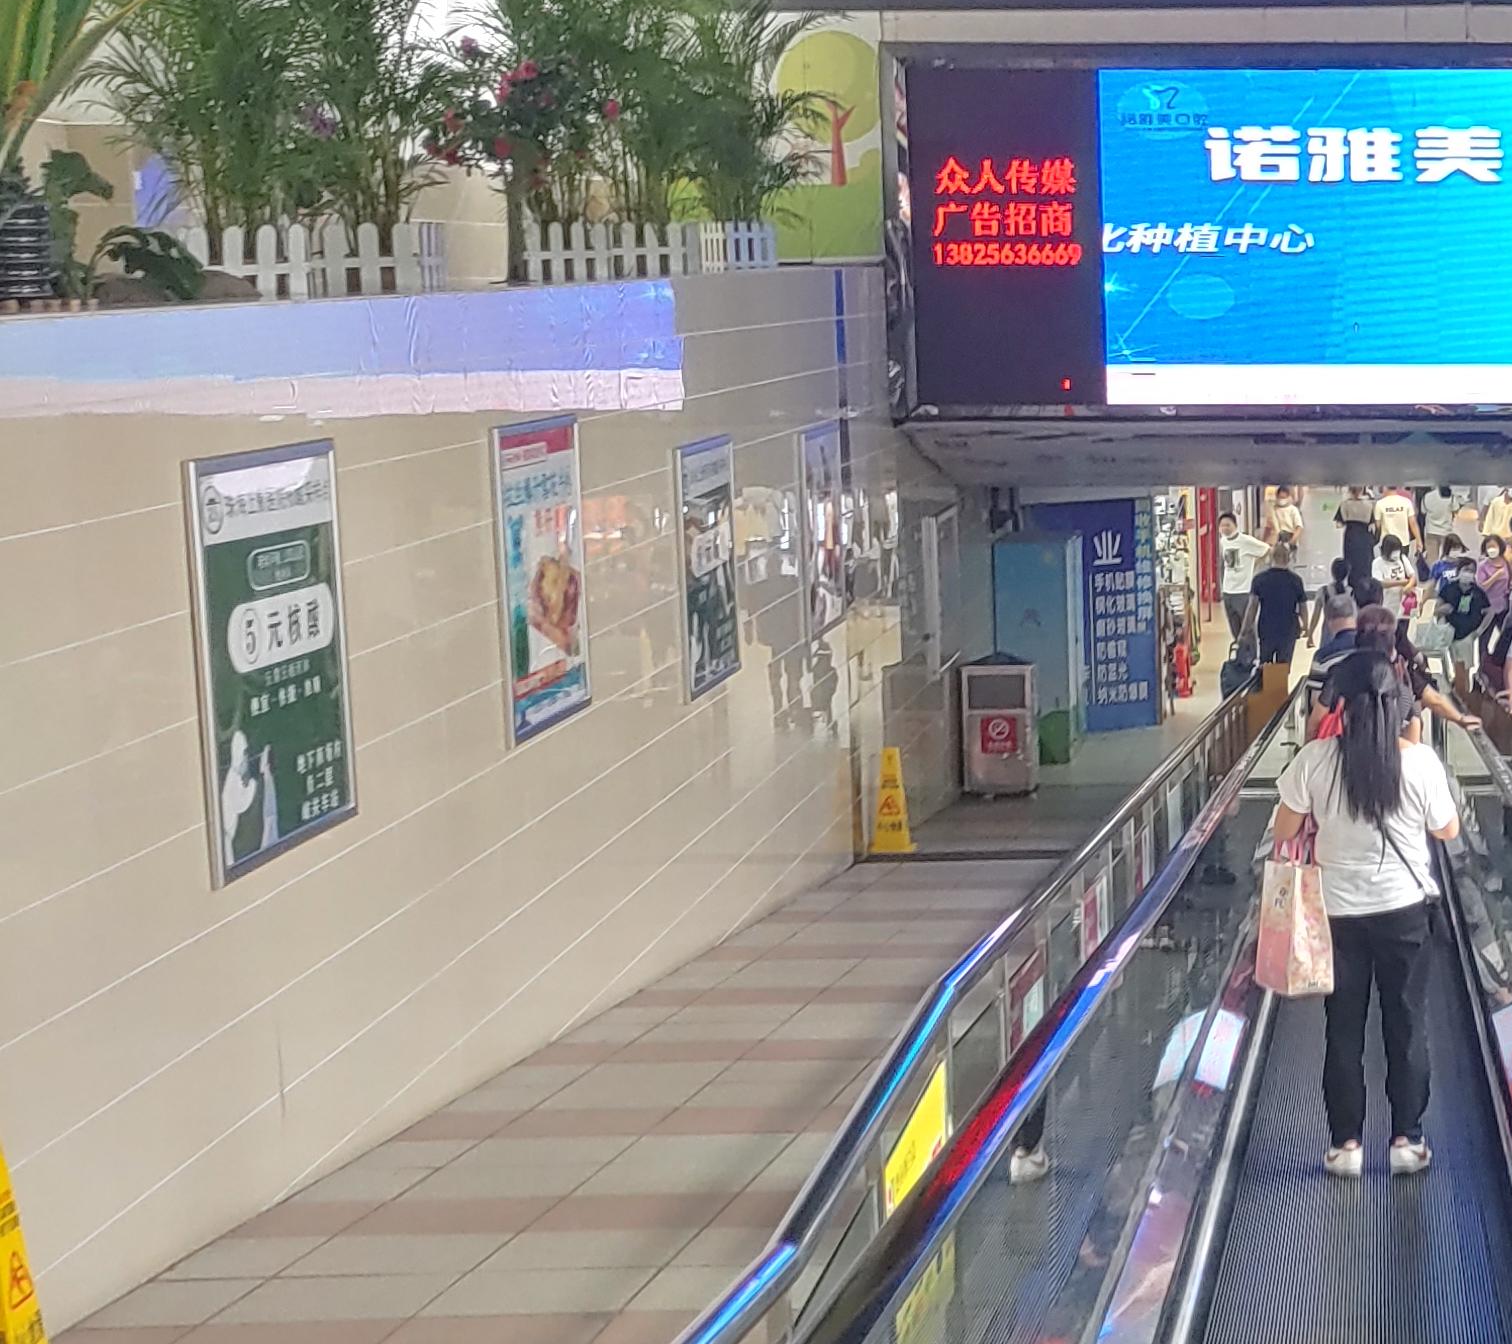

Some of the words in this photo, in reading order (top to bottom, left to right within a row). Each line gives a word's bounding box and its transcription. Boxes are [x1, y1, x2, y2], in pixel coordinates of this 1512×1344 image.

[934, 156, 1077, 195] 众人传媒
[933, 200, 1073, 237] 广告招商
[934, 242, 1083, 266] 13825636669
[1093, 529, 1122, 567] 业
